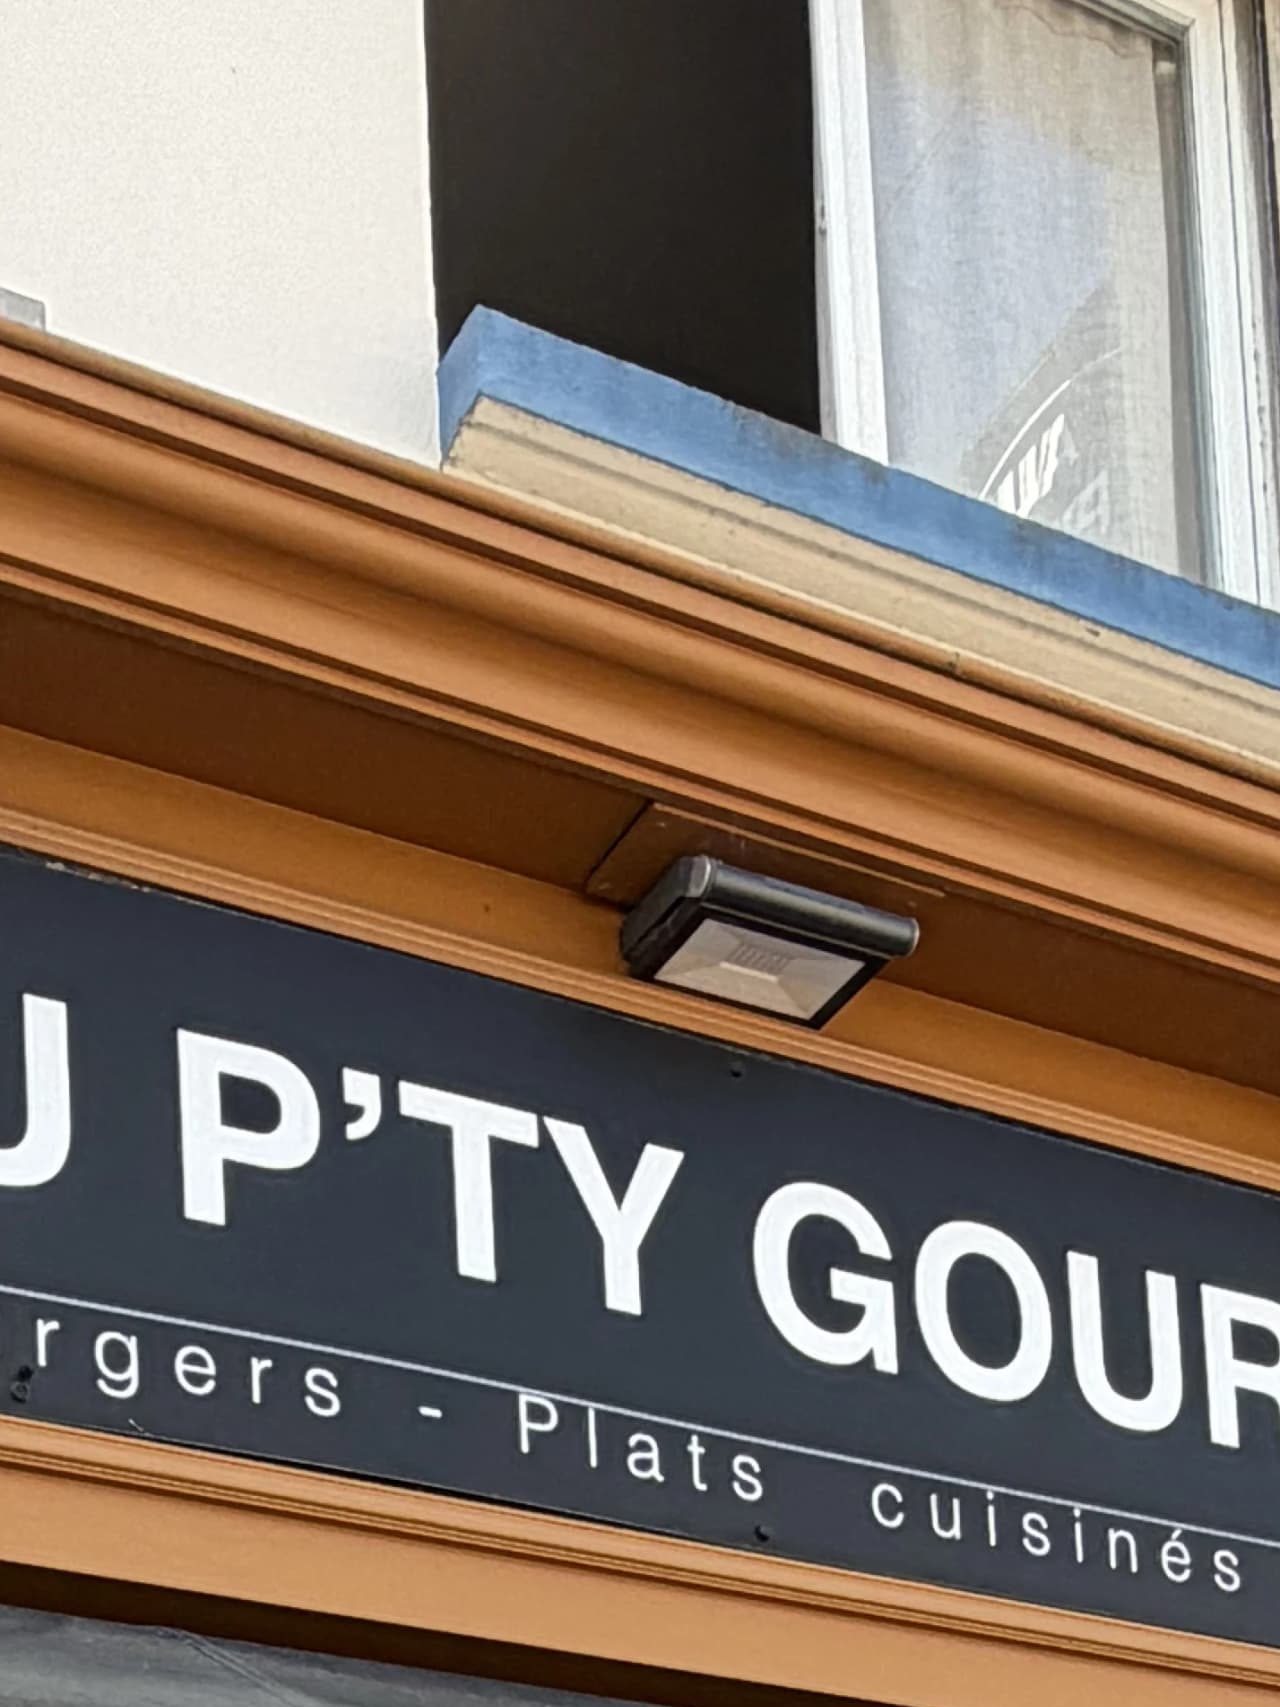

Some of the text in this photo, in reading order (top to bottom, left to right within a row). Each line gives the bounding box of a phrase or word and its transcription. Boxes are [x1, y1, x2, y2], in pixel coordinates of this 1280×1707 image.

[175, 1026, 684, 1318] P'TY
[517, 1398, 765, 1503] Plats
[869, 1476, 1243, 1592] cuisinés
